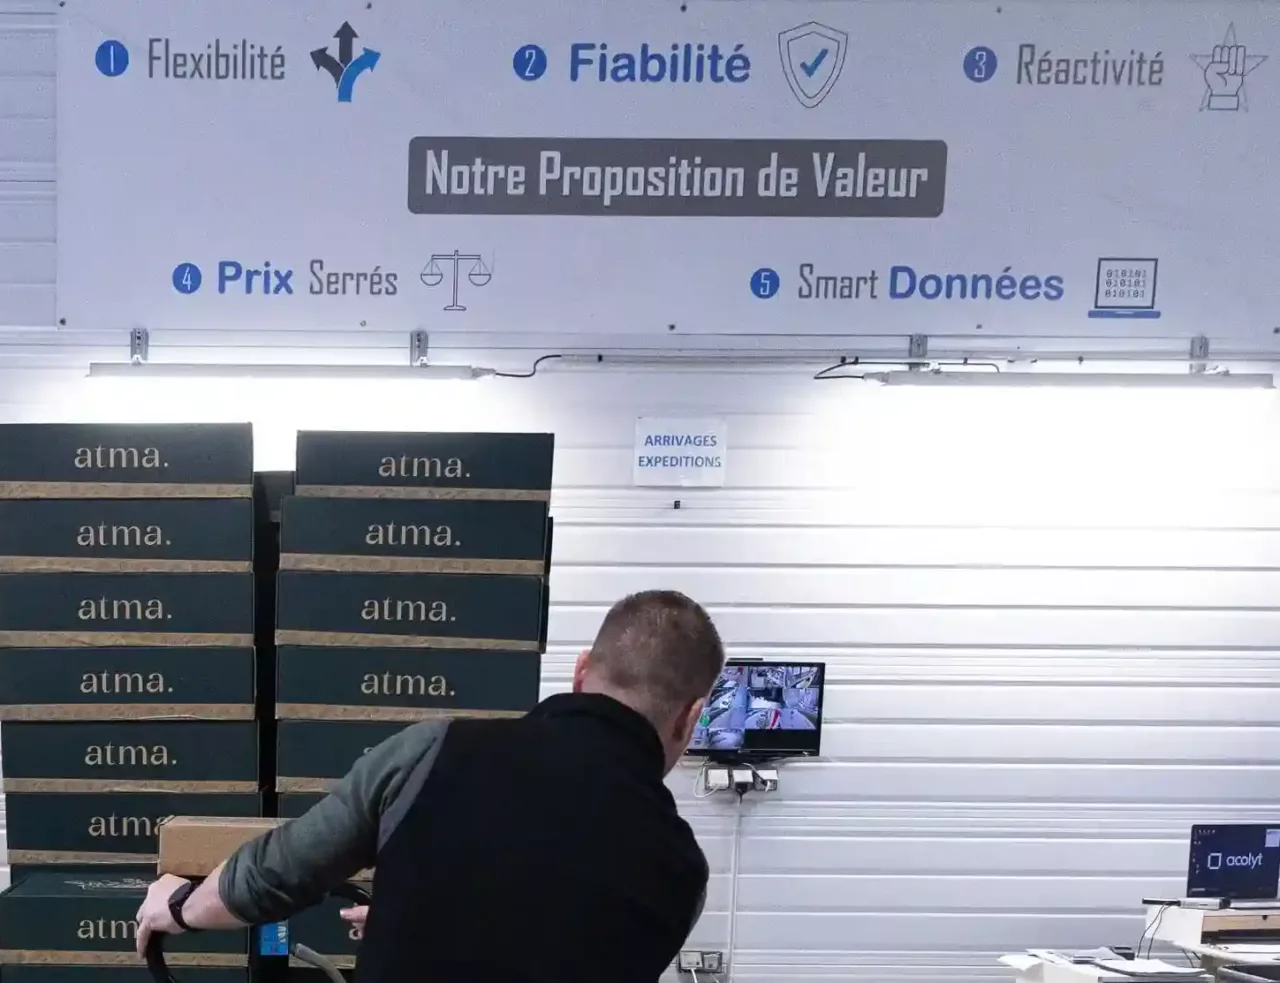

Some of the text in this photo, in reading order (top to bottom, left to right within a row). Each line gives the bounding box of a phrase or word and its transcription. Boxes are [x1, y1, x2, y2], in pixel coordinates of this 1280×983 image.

[147, 38, 286, 81] Flexibilité
[569, 42, 751, 83] Fiabilité
[1016, 43, 1164, 86] Réactivité
[425, 149, 928, 206] Notre Proposition de Valeur
[218, 260, 294, 295] Prix
[309, 259, 398, 296] Serrés
[798, 263, 878, 300] Smart
[889, 265, 1064, 301] Données
[644, 434, 718, 447] ARRIVAGES
[74, 444, 169, 469] atma.
[378, 454, 471, 479] atma.
[638, 455, 722, 468] EXPEDITIONS
[76, 521, 171, 546] atma.
[365, 521, 461, 547] atma.
[78, 595, 173, 620] atma.
[361, 596, 457, 622] atma.
[79, 669, 174, 694] atma.
[360, 670, 456, 697] atma.
[84, 741, 177, 766] atma.
[88, 812, 163, 837] atm
[1226, 852, 1263, 869] acolyt
[77, 916, 137, 940] atm
